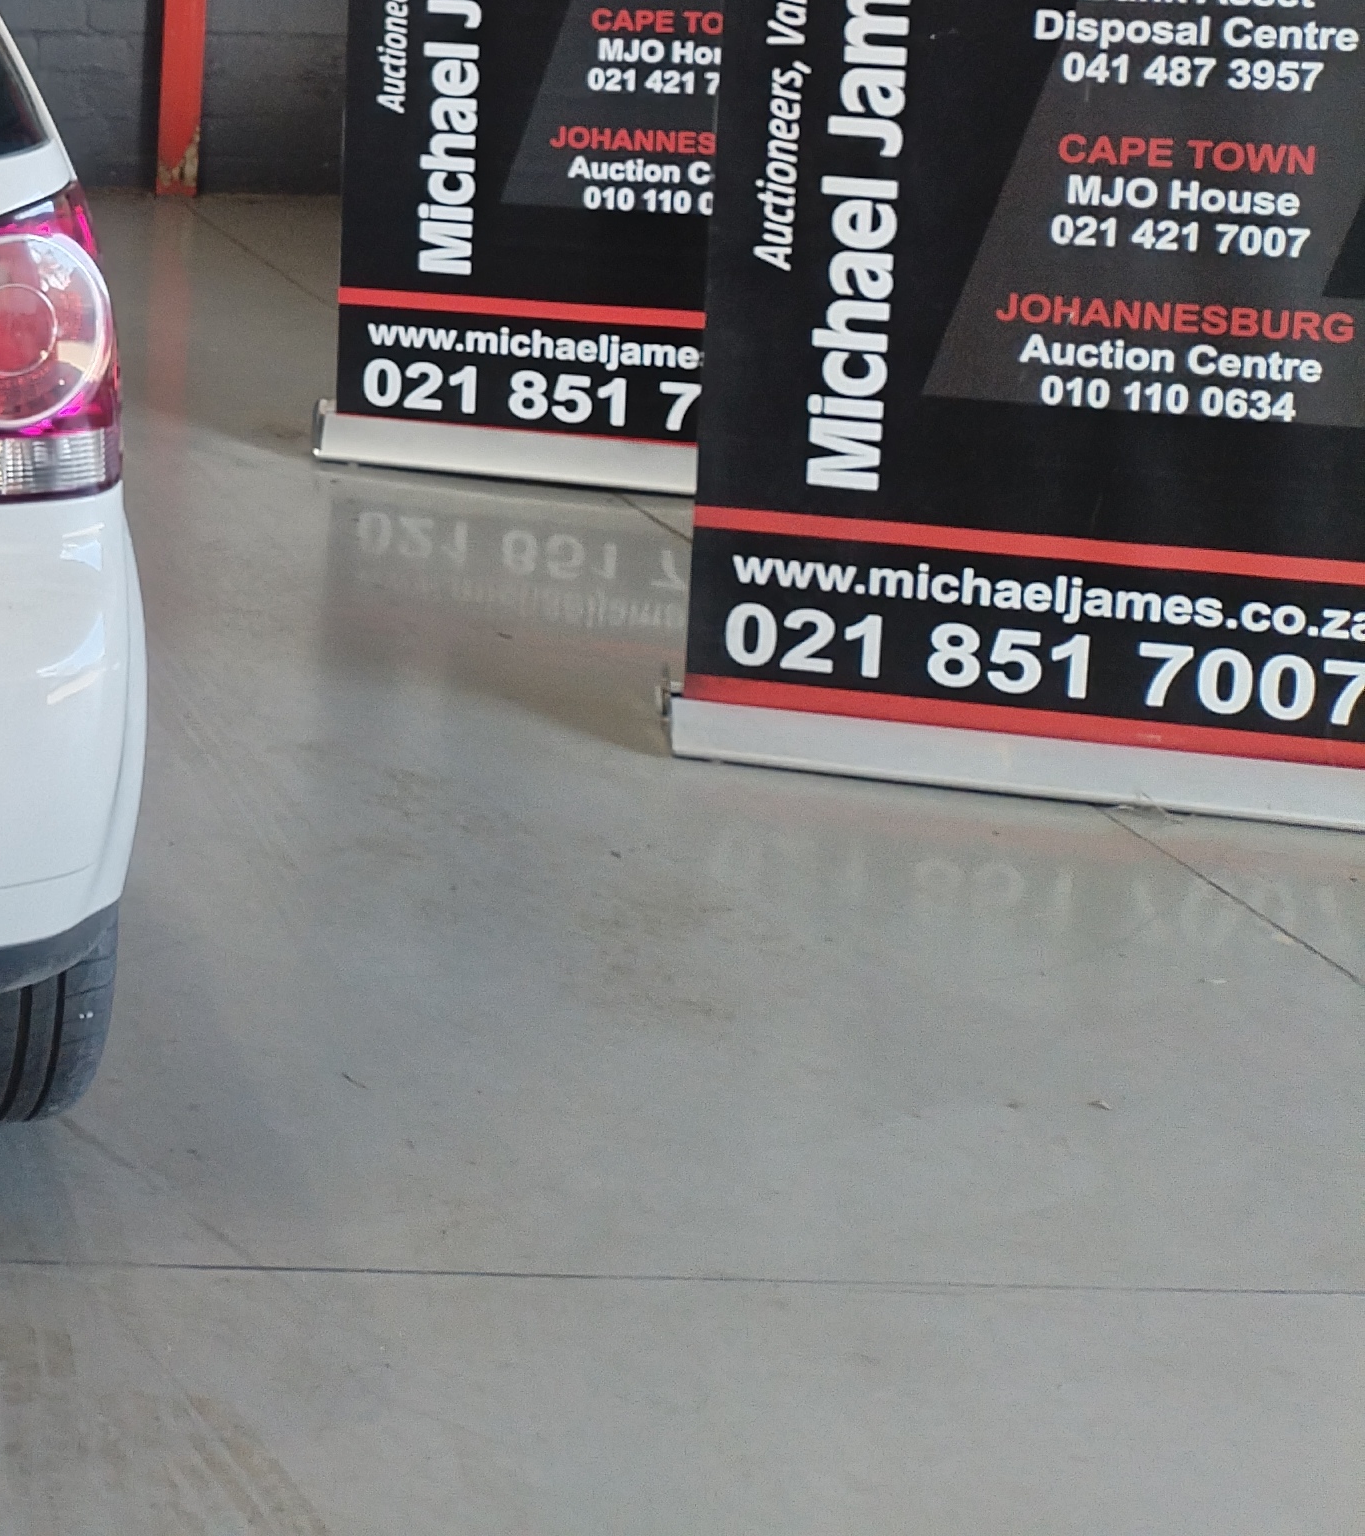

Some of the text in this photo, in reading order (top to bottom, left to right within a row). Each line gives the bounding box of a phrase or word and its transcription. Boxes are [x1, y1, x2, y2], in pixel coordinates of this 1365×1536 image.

[590, 7, 675, 34] CAPE
[1034, 9, 1360, 52] Disposal Centre
[597, 37, 665, 64] MJO
[1062, 51, 1325, 92] 041 487 3957
[586, 67, 636, 92] 021
[643, 69, 695, 95] 421
[417, 41, 480, 276] Michael
[567, 155, 681, 184] Auction
[752, 60, 812, 272] Auctioneers,
[1057, 133, 1317, 176] CAPE TOWN
[1066, 174, 1301, 217] MJO House
[1050, 214, 1311, 259] 021 421 7007
[805, 175, 899, 492] Michael
[995, 292, 1355, 344] JOHANNESBURG
[1018, 333, 1323, 384] Auction Centre
[363, 358, 627, 427] 021 851
[1039, 374, 1297, 423] 010 110 0634
[725, 602, 1365, 726] 021 851 7007
